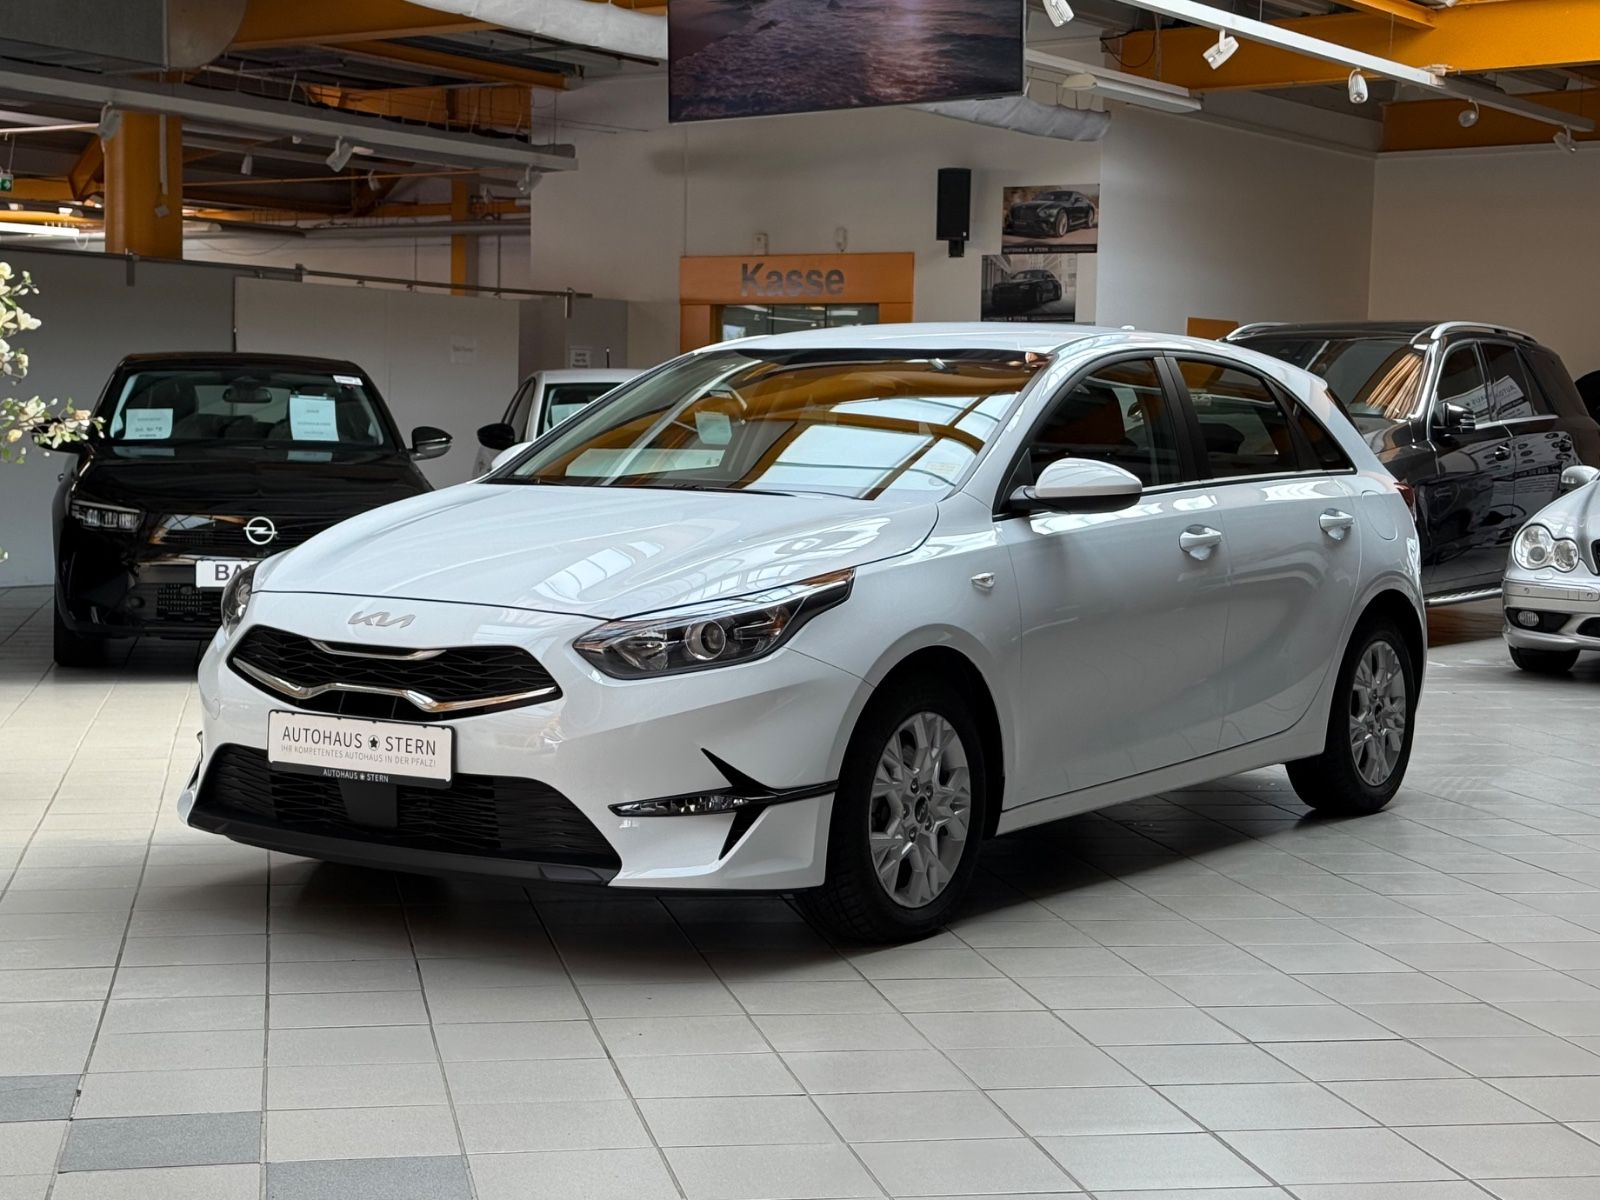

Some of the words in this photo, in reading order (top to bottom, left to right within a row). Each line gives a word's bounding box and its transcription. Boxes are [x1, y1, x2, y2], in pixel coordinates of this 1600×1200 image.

[741, 263, 845, 297] Kasse
[282, 726, 362, 749] AUTOHAUS
[385, 736, 436, 756] STERN
[281, 744, 293, 753] IHR
[294, 745, 343, 759] KOMPETENTES
[344, 751, 383, 763] AUTOHAUS
[385, 755, 392, 764] IN
[394, 756, 409, 765] DER
[411, 757, 436, 768] PFALZ!
[322, 769, 358, 780] AUTOHAUS
[366, 773, 389, 783] STERN
